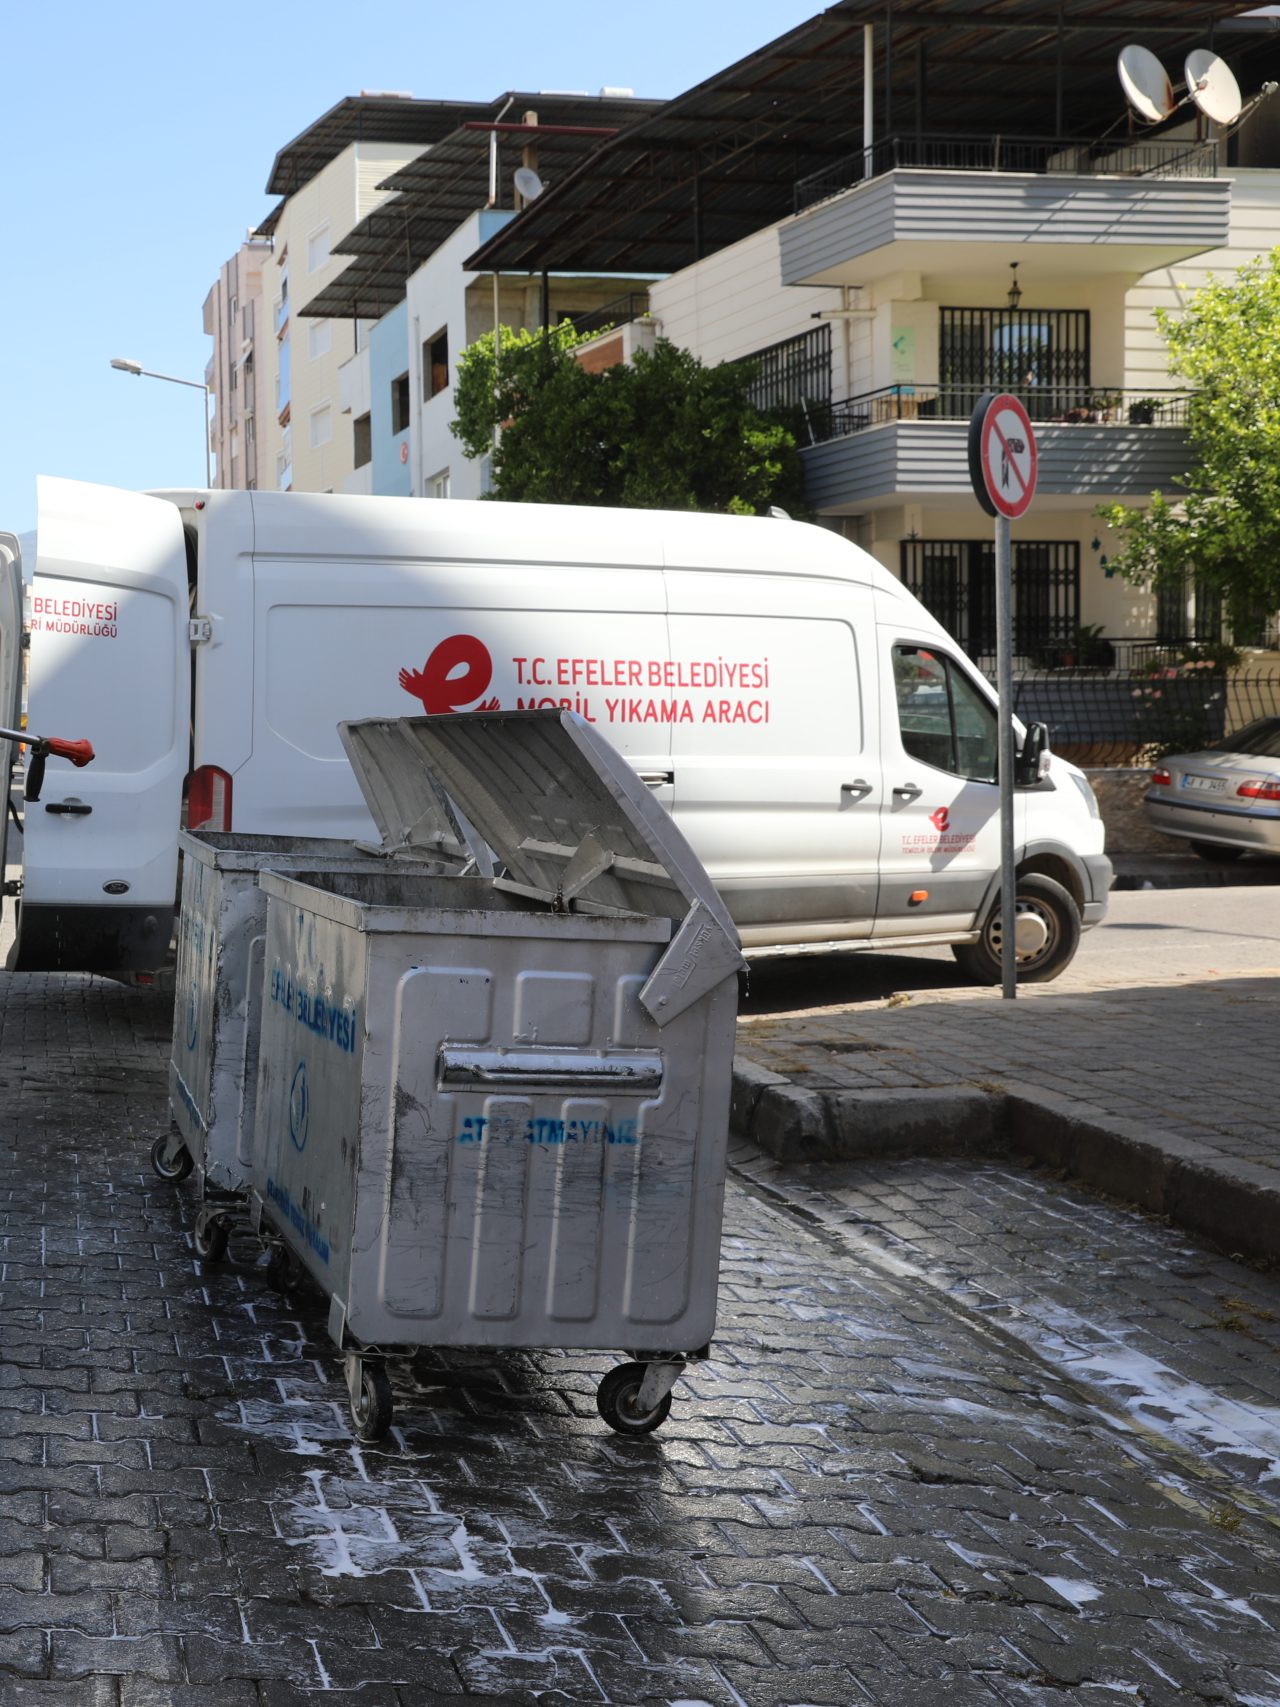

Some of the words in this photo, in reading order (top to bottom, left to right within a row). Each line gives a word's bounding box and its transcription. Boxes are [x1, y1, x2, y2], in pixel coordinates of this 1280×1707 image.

[33, 597, 118, 622] BELEDİYESİ
[45, 618, 118, 639] MÜDÜRLÜĞÜ
[512, 657, 553, 686] T.C.
[556, 658, 643, 687] EFELER
[648, 655, 769, 689] BELEDİYESİ
[604, 698, 694, 724] YIKAMA
[701, 699, 769, 724] ARACI
